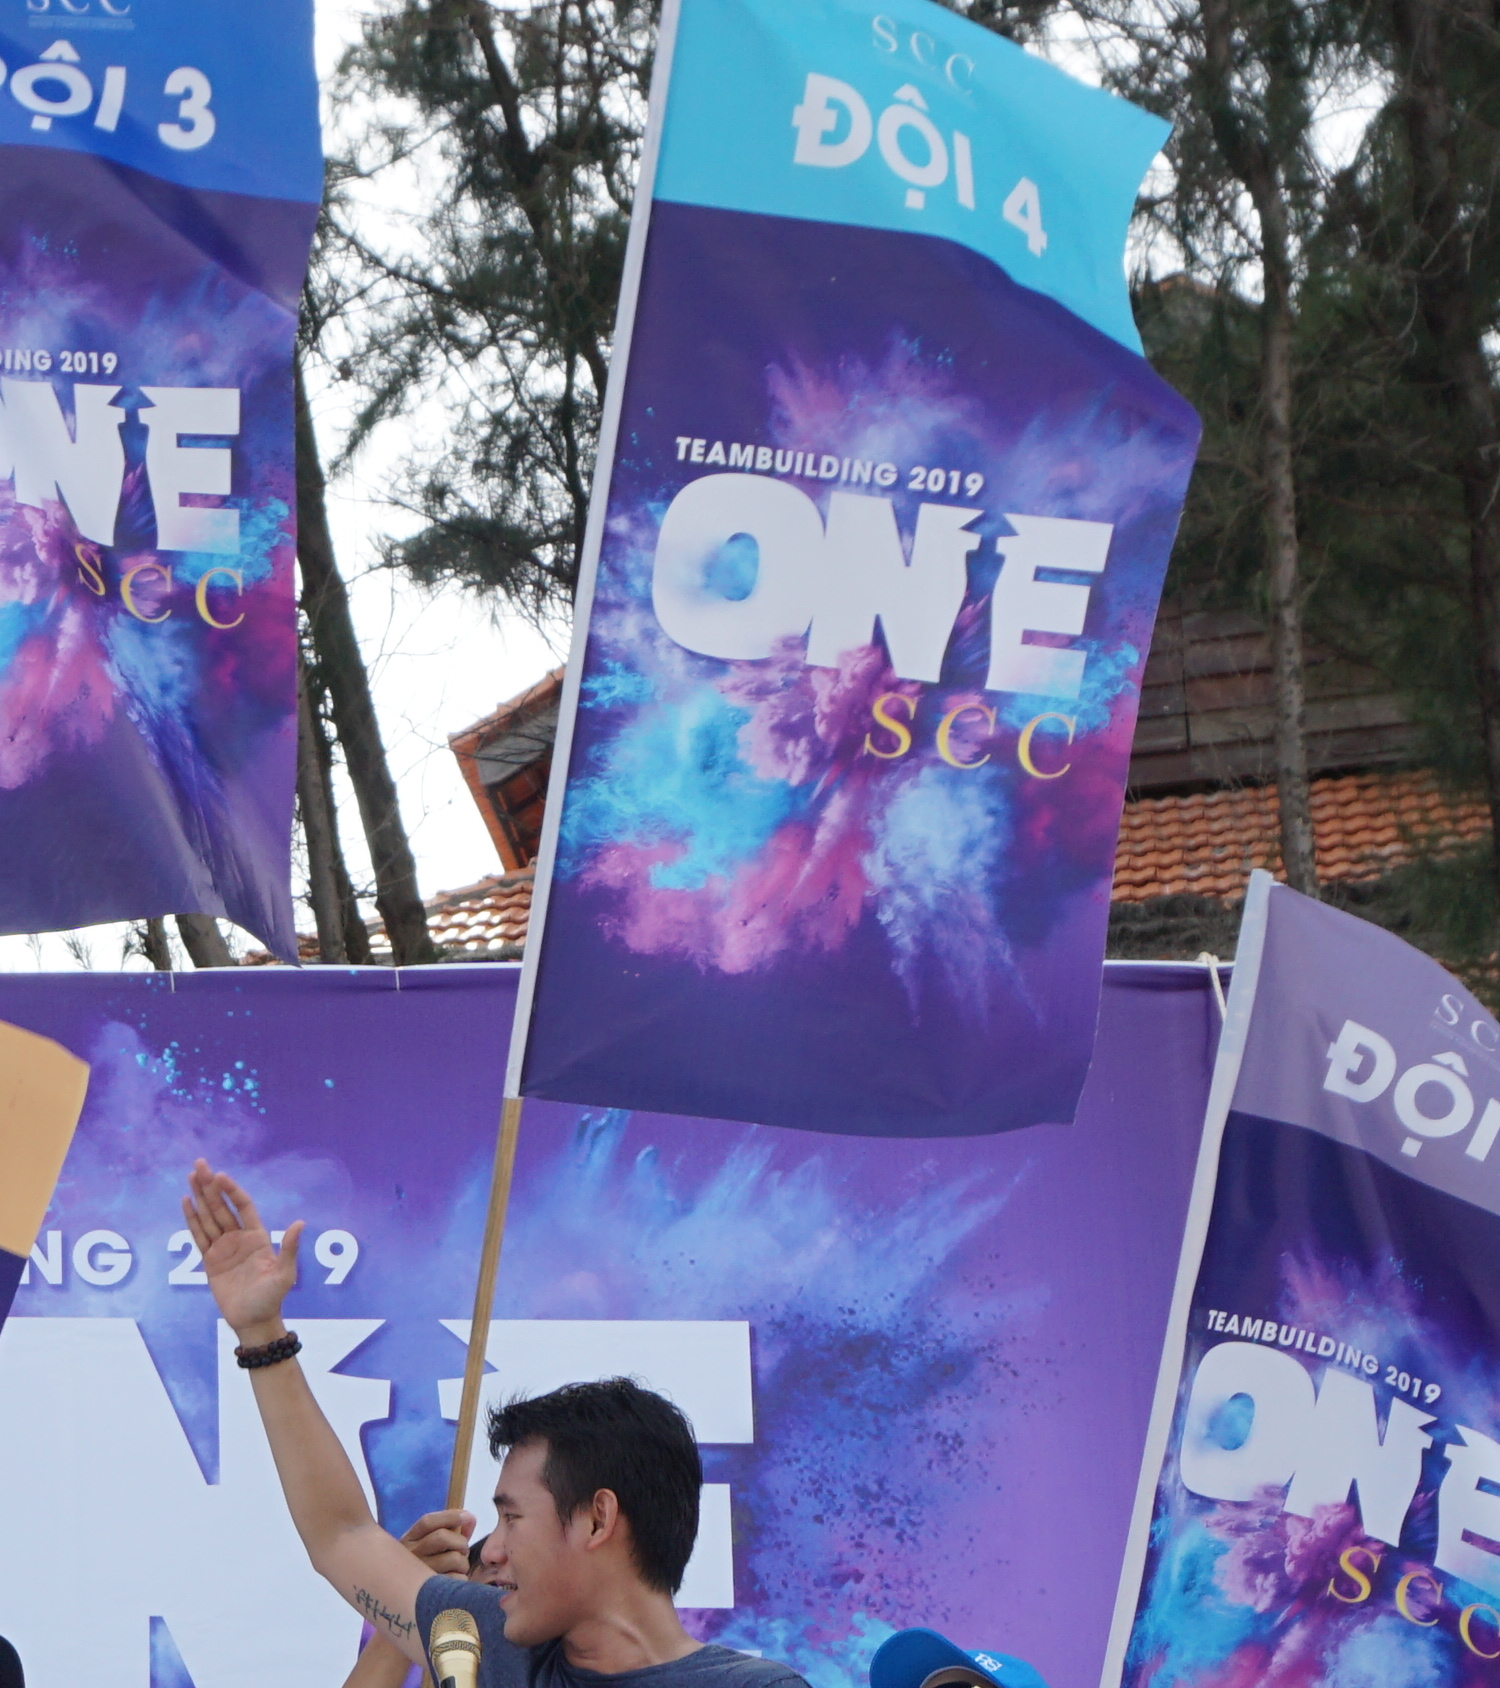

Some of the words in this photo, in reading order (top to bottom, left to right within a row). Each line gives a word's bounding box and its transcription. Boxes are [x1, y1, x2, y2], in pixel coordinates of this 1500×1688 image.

[872, 14, 976, 96] SCC
[157, 66, 216, 151] 3
[791, 72, 975, 211] ĐỘI
[1003, 176, 1048, 258] 4
[59, 350, 118, 375] 2019
[676, 436, 898, 487] TEAMBUILDING
[908, 465, 984, 498] 2019
[74, 543, 245, 630] SCC
[652, 472, 1114, 700] ONE
[864, 691, 1077, 780] SCC
[1207, 1309, 1379, 1375] TEAMBUILDING
[1385, 1365, 1442, 1404] 2019
